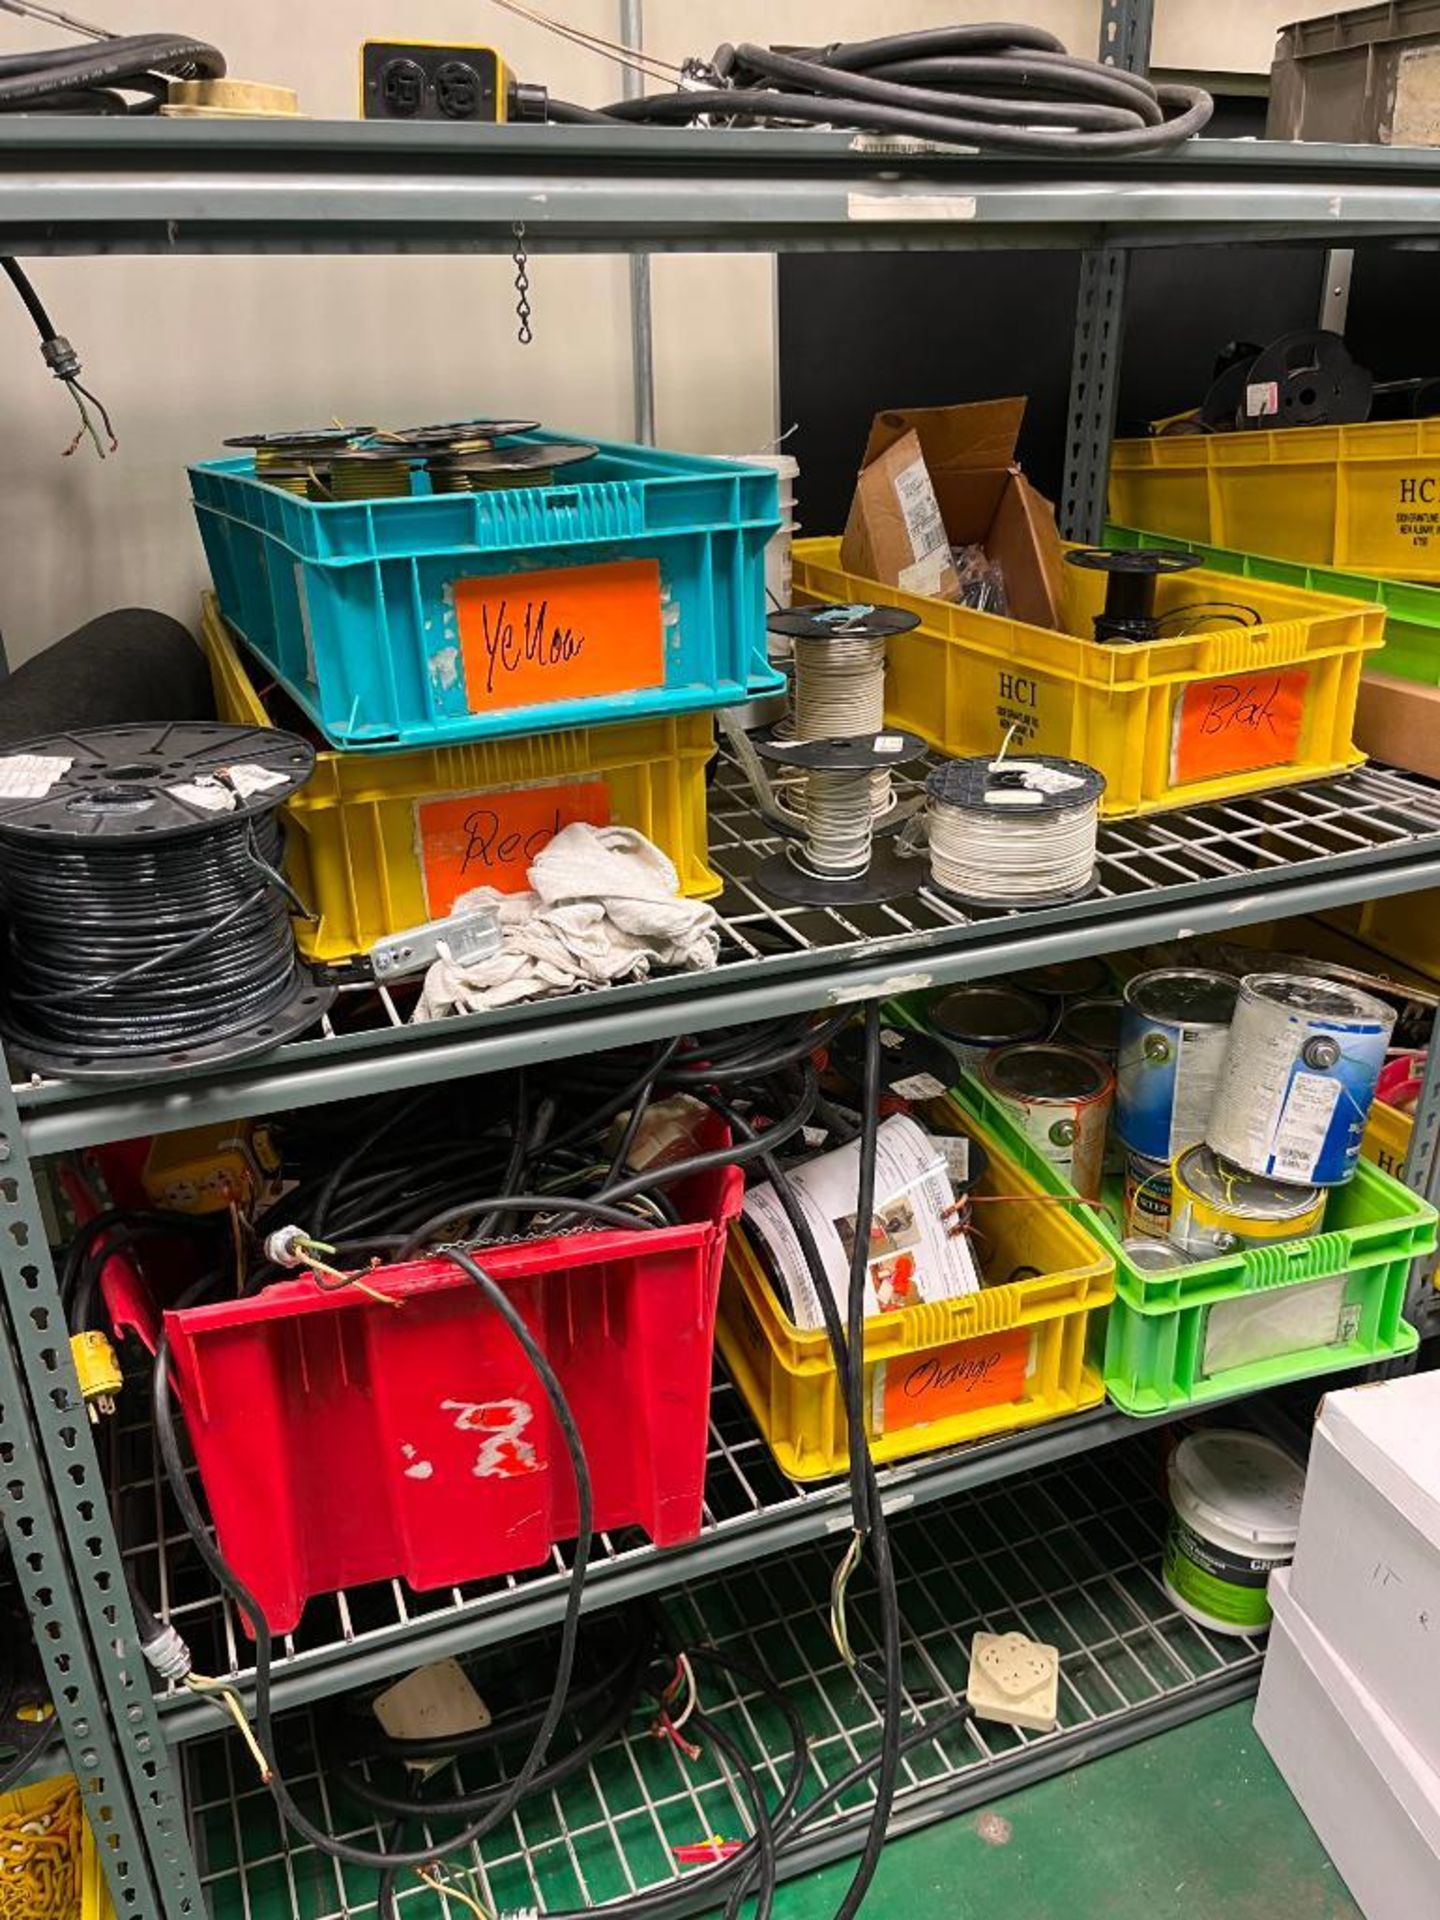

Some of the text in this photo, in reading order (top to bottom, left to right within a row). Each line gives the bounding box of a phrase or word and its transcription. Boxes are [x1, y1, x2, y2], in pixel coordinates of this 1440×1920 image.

[1399, 478, 1440, 503] HC
[482, 600, 585, 693] Yellow
[999, 671, 1037, 707] HCI
[460, 808, 559, 875] Red
